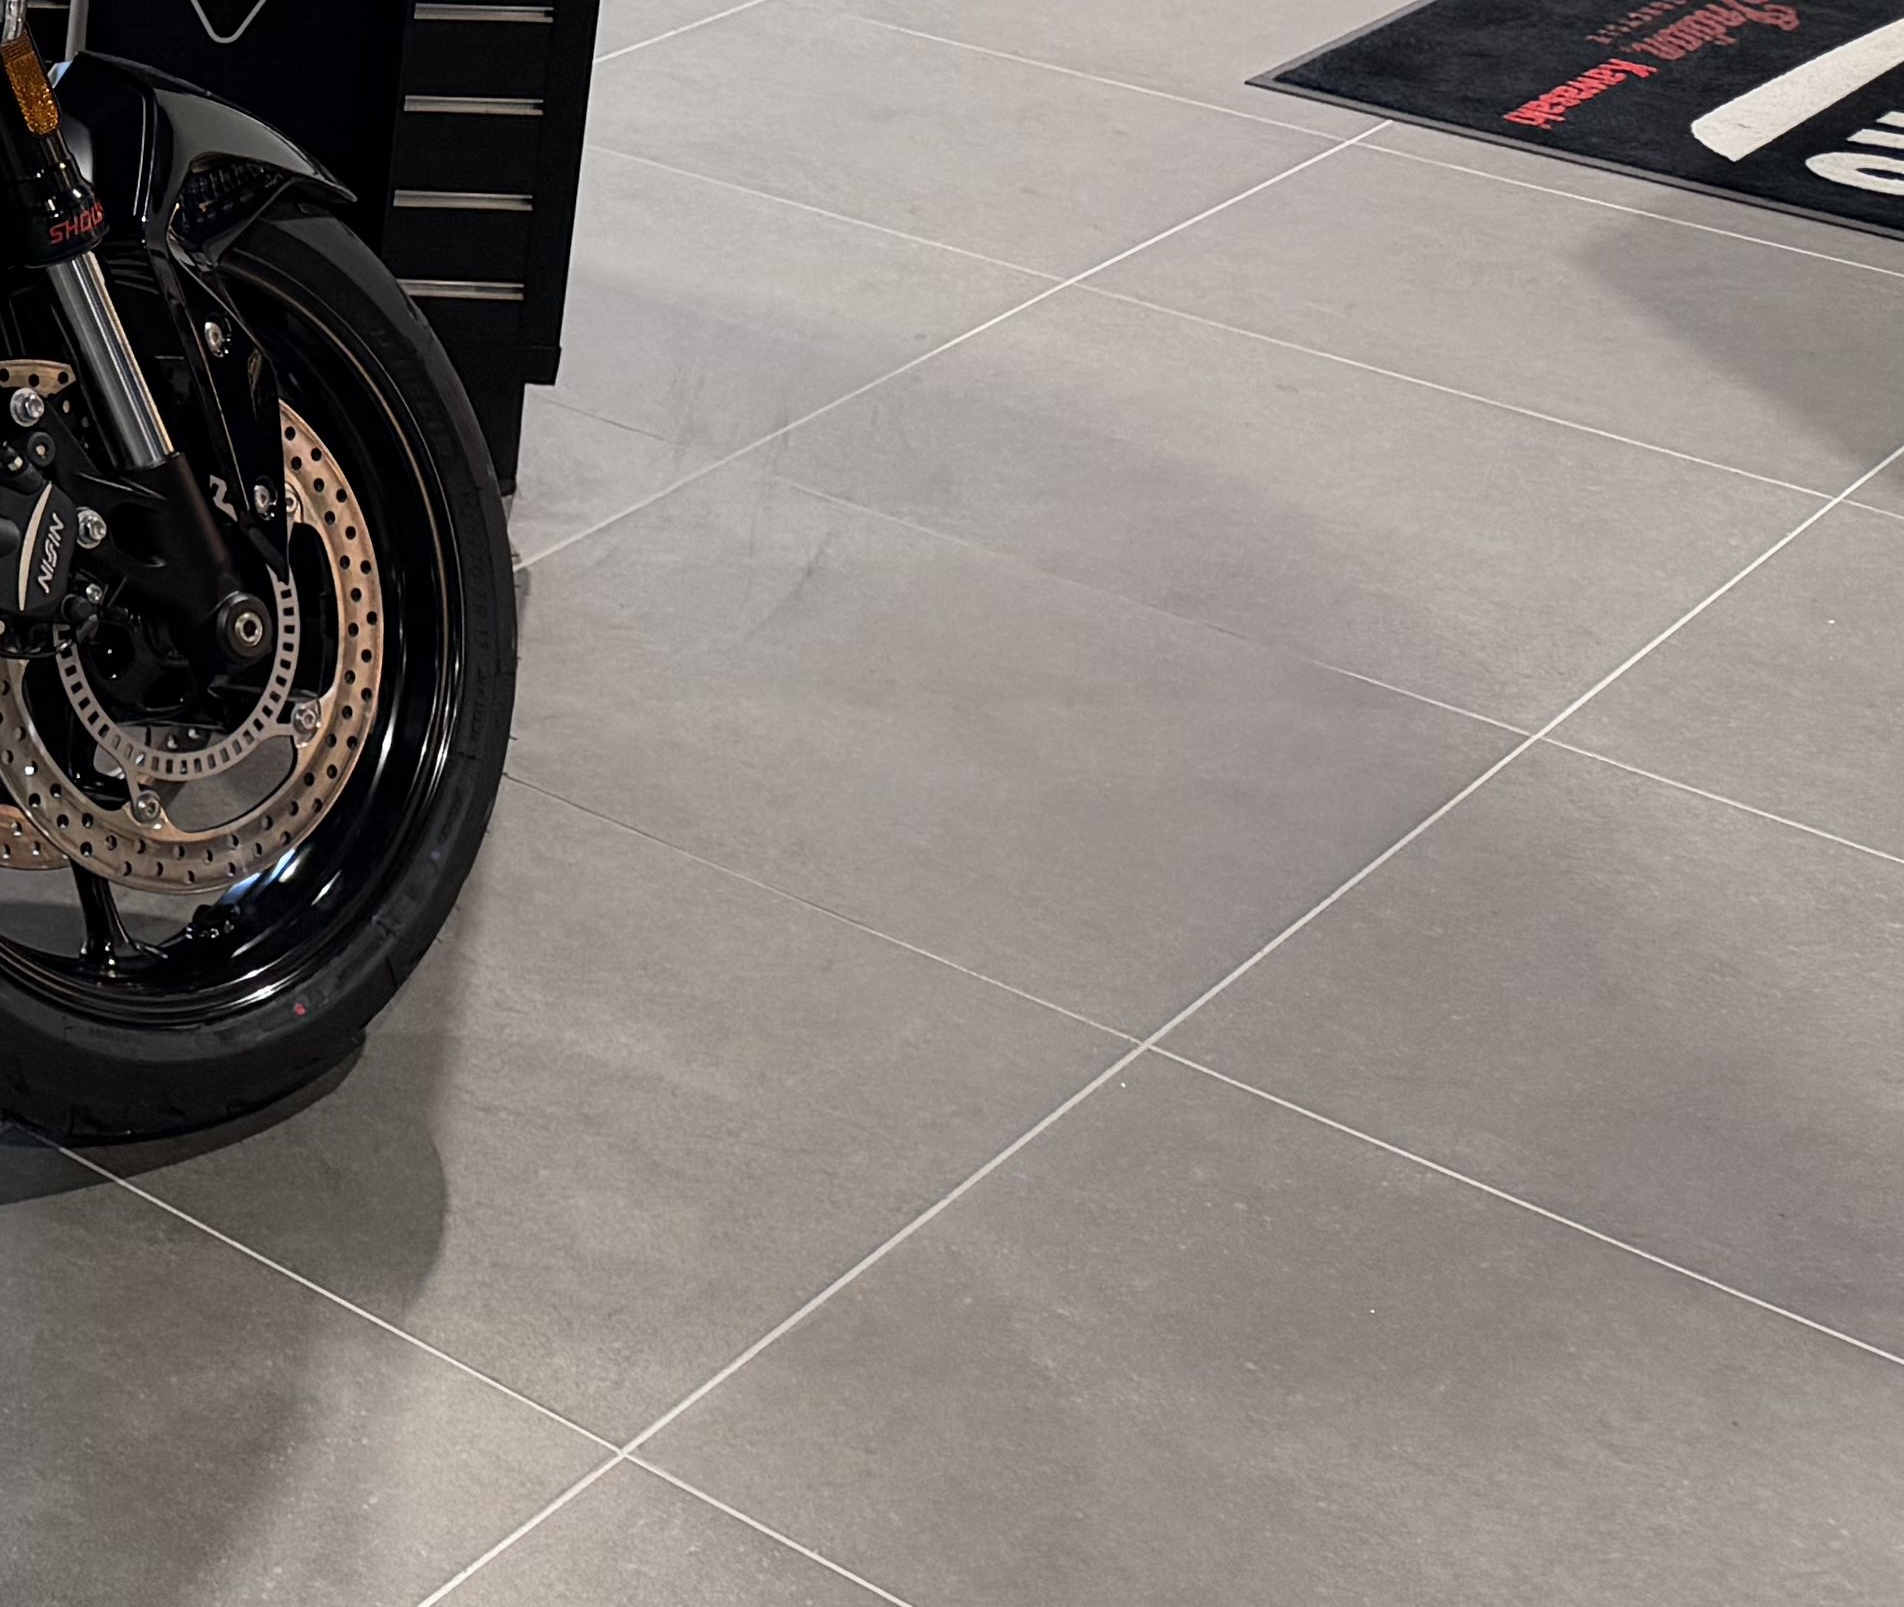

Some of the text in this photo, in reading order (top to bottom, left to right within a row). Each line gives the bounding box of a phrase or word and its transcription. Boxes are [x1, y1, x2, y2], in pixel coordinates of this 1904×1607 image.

[1503, 58, 1658, 130] Kawasaki
[49, 201, 104, 246] SHO
[37, 512, 65, 594] NISSIN
